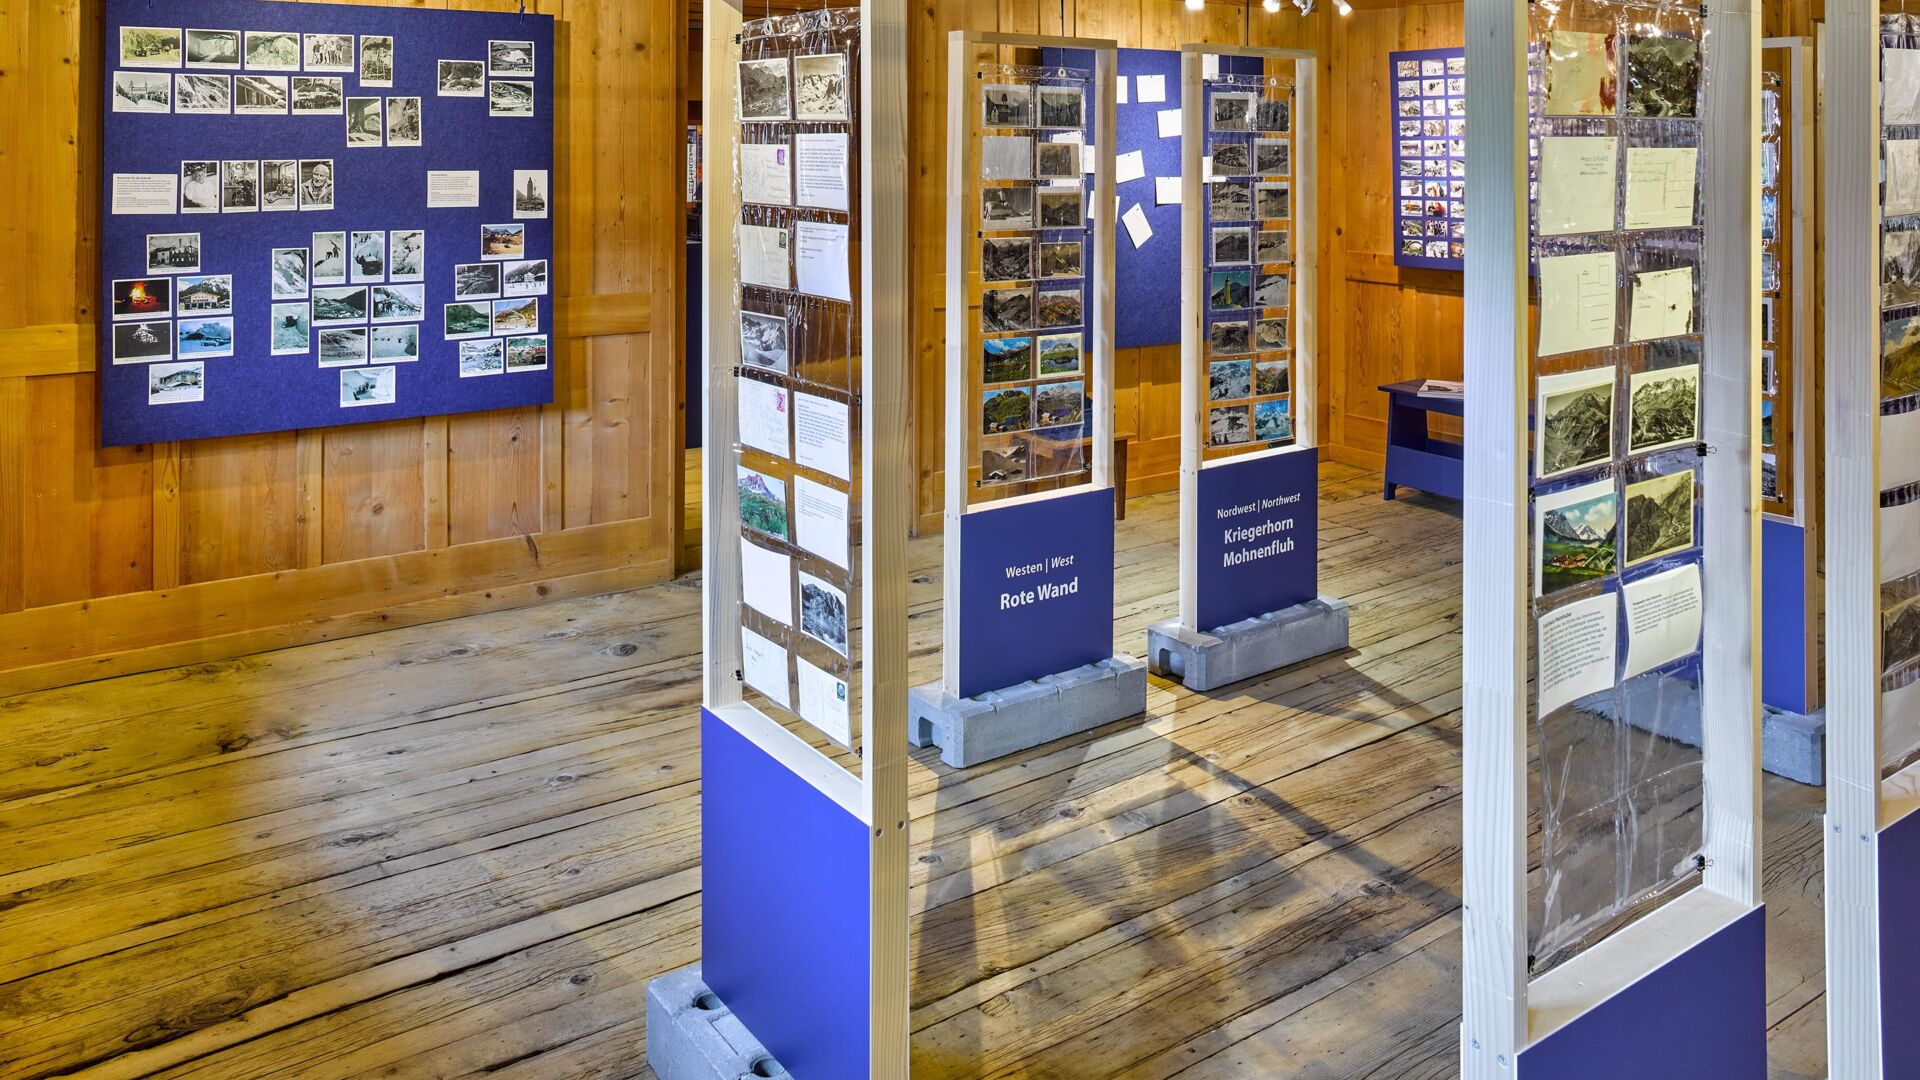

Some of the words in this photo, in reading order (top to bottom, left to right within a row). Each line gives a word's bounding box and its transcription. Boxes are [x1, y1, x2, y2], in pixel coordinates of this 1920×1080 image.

[1217, 502, 1256, 519] Nordwest
[1262, 493, 1301, 509] Northwest
[1224, 518, 1294, 544] Kriegerhorn
[1223, 536, 1294, 567] Mohnenfluh
[1005, 563, 1043, 578] Westen
[1051, 555, 1074, 569] West
[1000, 590, 1035, 610] Rote
[1037, 576, 1078, 601] Wand
